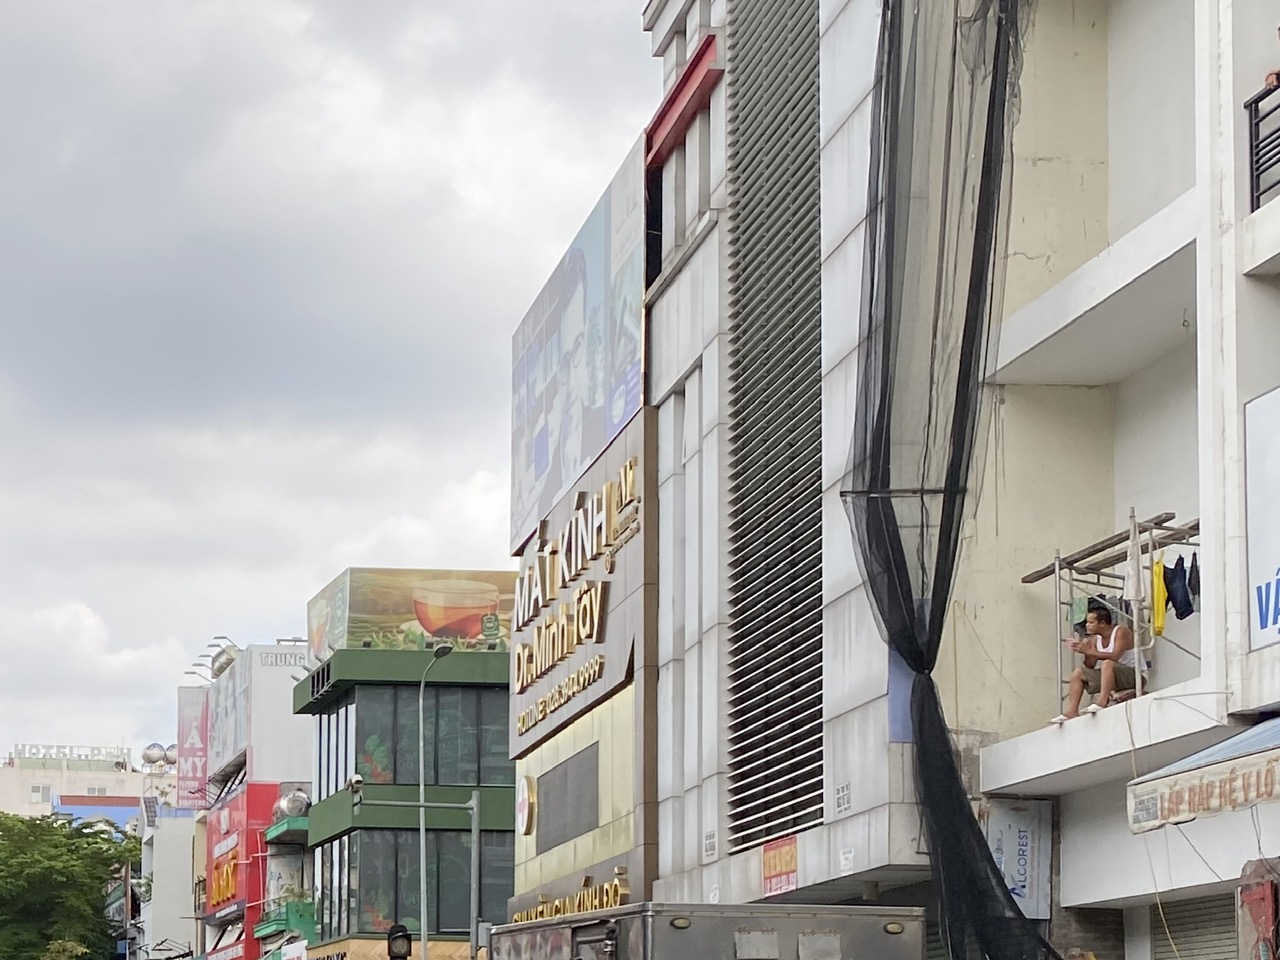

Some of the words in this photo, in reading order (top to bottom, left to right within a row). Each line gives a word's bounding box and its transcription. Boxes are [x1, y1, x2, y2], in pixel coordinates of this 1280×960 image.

[514, 519, 560, 632] MẮT
[559, 482, 613, 589] KÍNH
[260, 652, 305, 667] TRUNG
[14, 743, 74, 761] HOTEL
